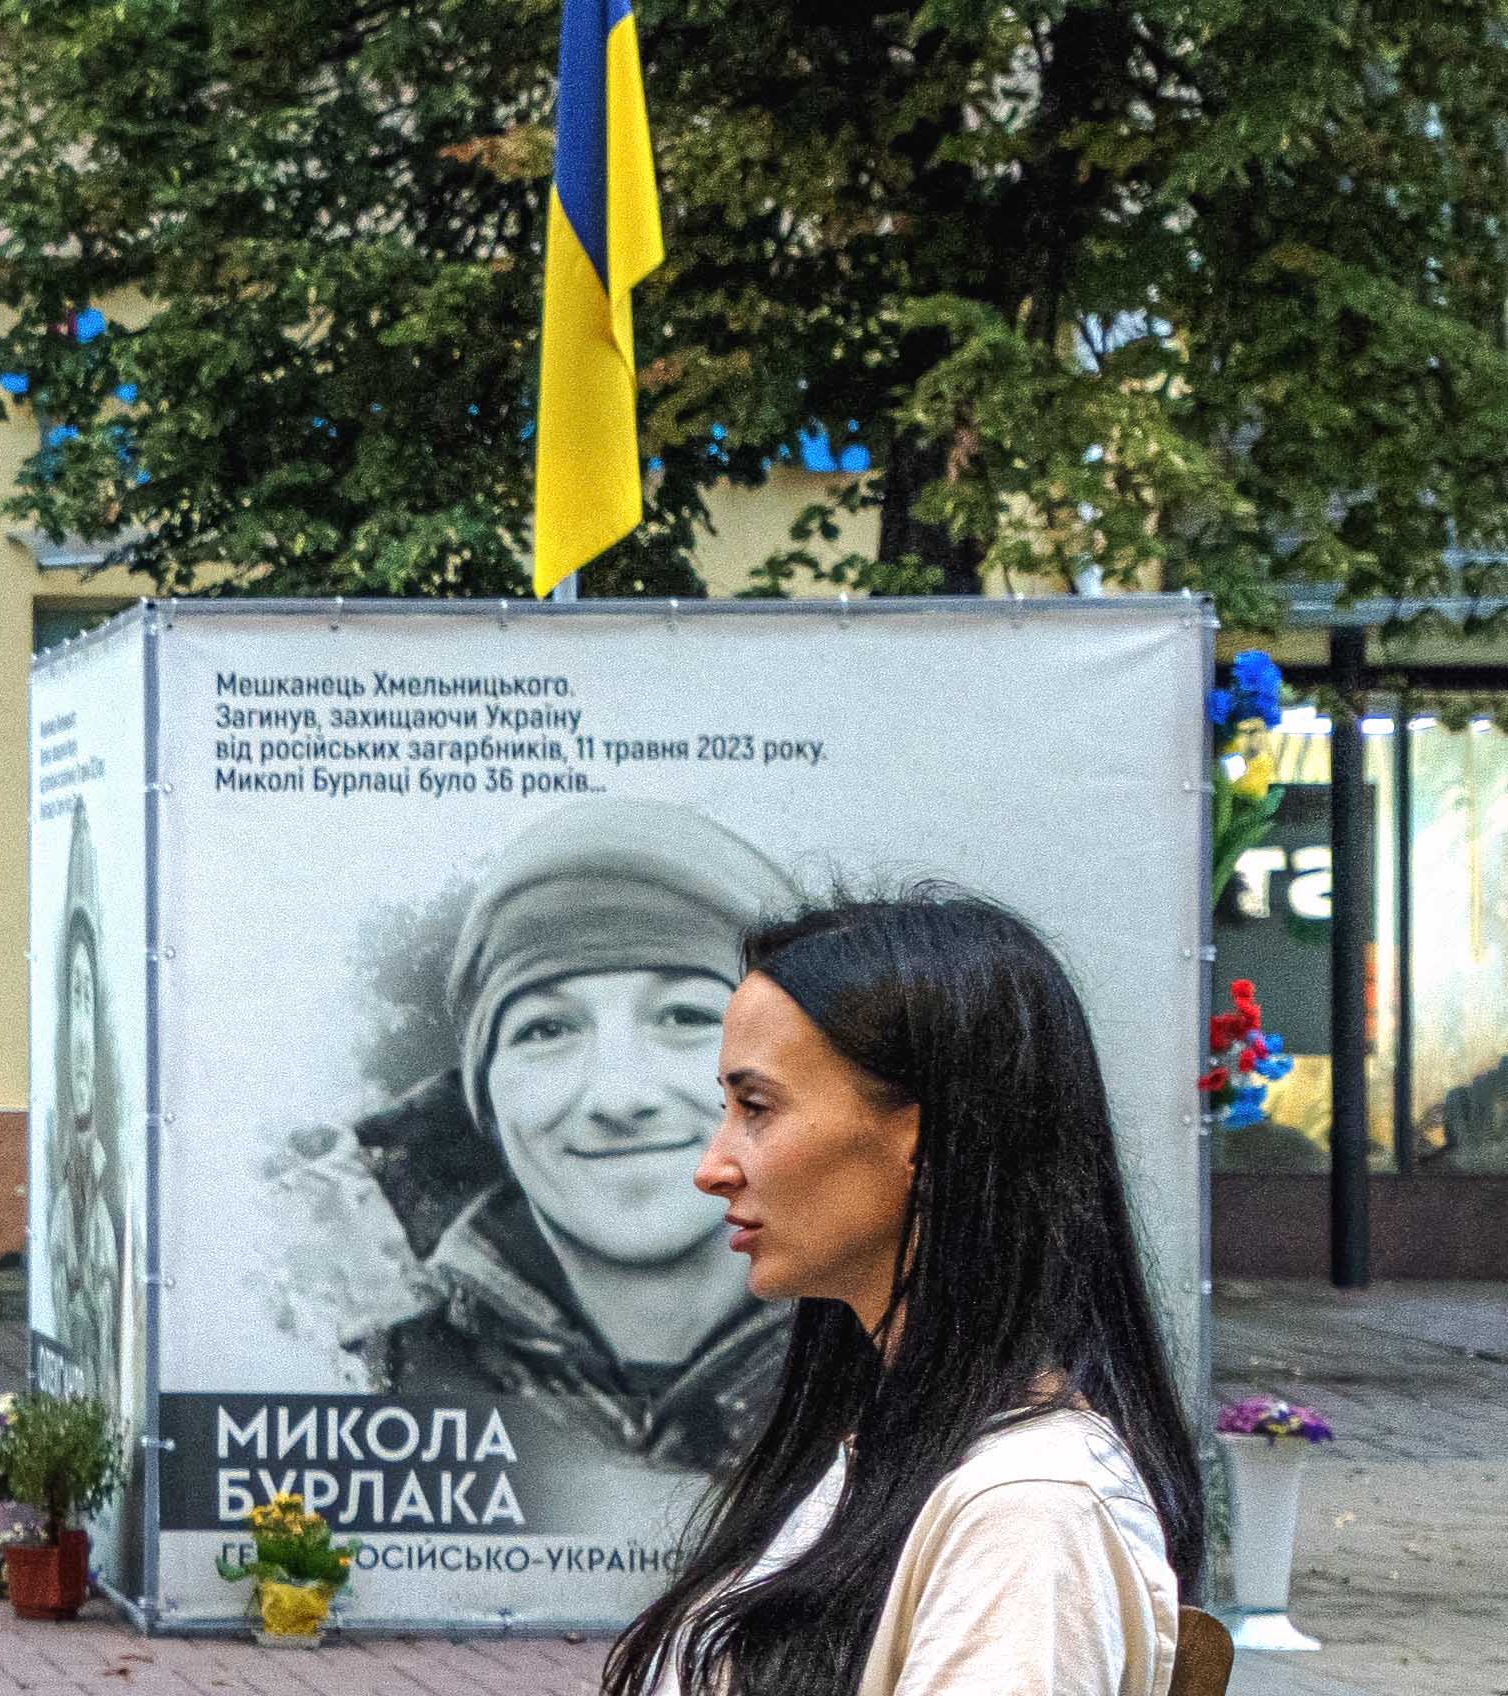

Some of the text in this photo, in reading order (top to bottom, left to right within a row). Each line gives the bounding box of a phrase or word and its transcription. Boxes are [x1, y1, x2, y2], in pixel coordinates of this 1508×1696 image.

[217, 672, 575, 700] Мешканець Хмельницького.
[216, 703, 582, 734] Загинув, захищаючи Україну
[216, 734, 827, 765] від російських загарбників, 11 травня 2023 року.
[216, 766, 305, 792] Миколі
[313, 766, 410, 797] Бурлаці
[419, 766, 477, 797] було
[485, 767, 514, 792] 36
[217, 1406, 518, 1463] МИКОЛА
[217, 1468, 526, 1525] БУРЛАКА
